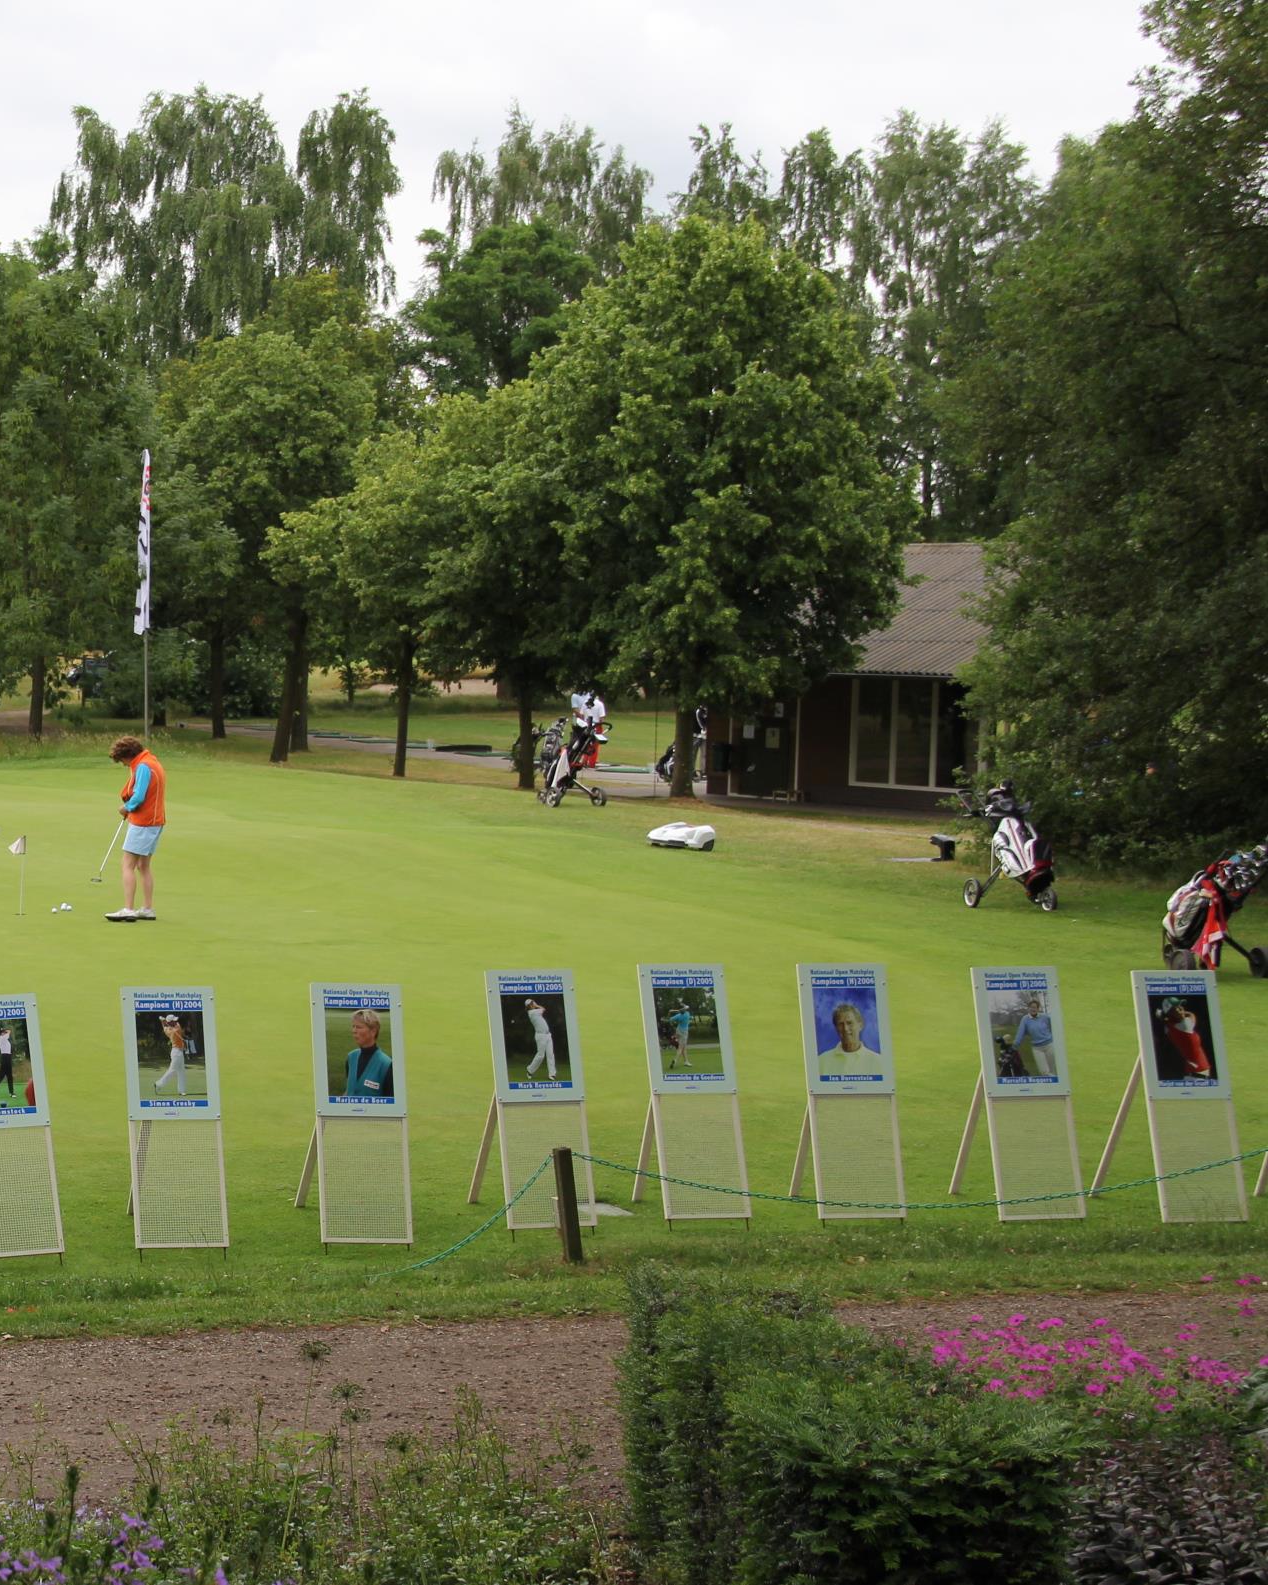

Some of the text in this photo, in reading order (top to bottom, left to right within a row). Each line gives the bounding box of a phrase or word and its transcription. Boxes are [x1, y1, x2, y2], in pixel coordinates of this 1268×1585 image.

[652, 978, 684, 986] Kampioen
[812, 978, 844, 986] Kampioen
[987, 981, 1017, 989] Kampioen
[500, 984, 532, 992] Kampioen
[135, 1002, 169, 1010] Kampioen
[324, 998, 358, 1006] Kampioen
